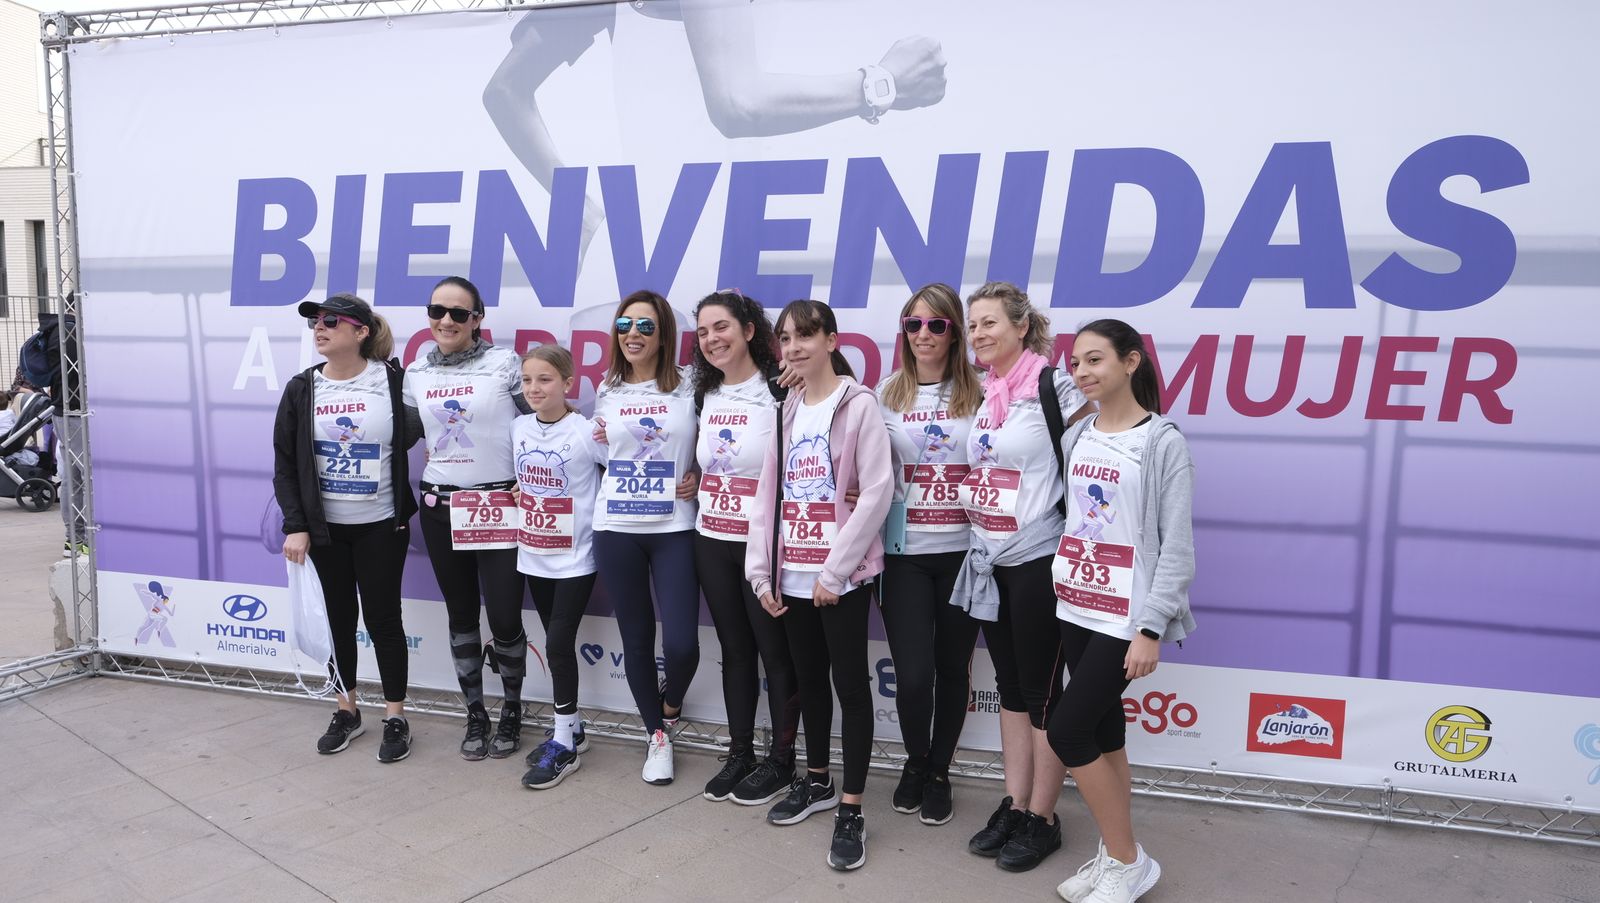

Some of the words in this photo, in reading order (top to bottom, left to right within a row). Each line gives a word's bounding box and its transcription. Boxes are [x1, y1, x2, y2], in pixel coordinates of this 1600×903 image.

[231, 135, 1530, 311] BIENVENIDAS
[233, 326, 279, 391] A
[426, 386, 474, 399] MUJER
[316, 403, 366, 416] MUJER
[620, 405, 668, 416] MUJER
[708, 415, 748, 425] MUJER
[326, 457, 362, 475] 221
[526, 464, 552, 478] MINI
[1072, 463, 1120, 484] MUJER
[518, 472, 564, 489] RUNNER
[615, 477, 665, 494] 2044
[919, 483, 959, 502] 785
[969, 487, 1000, 508] 792
[709, 493, 742, 513] 783
[466, 507, 504, 523] 799
[525, 511, 557, 529] 802
[789, 521, 824, 540] 784
[1067, 559, 1111, 586] 793
[1062, 577, 1072, 585] LAS
[1073, 580, 1117, 594] ALMENDRICAS
[207, 623, 285, 643] HYUNDAI
[217, 640, 277, 657] Almerialva
[1167, 729, 1182, 738] sport
[1183, 731, 1202, 739] center
[1262, 718, 1329, 736] Lanjarón
[1394, 761, 1518, 783] GRUTALMERIA
